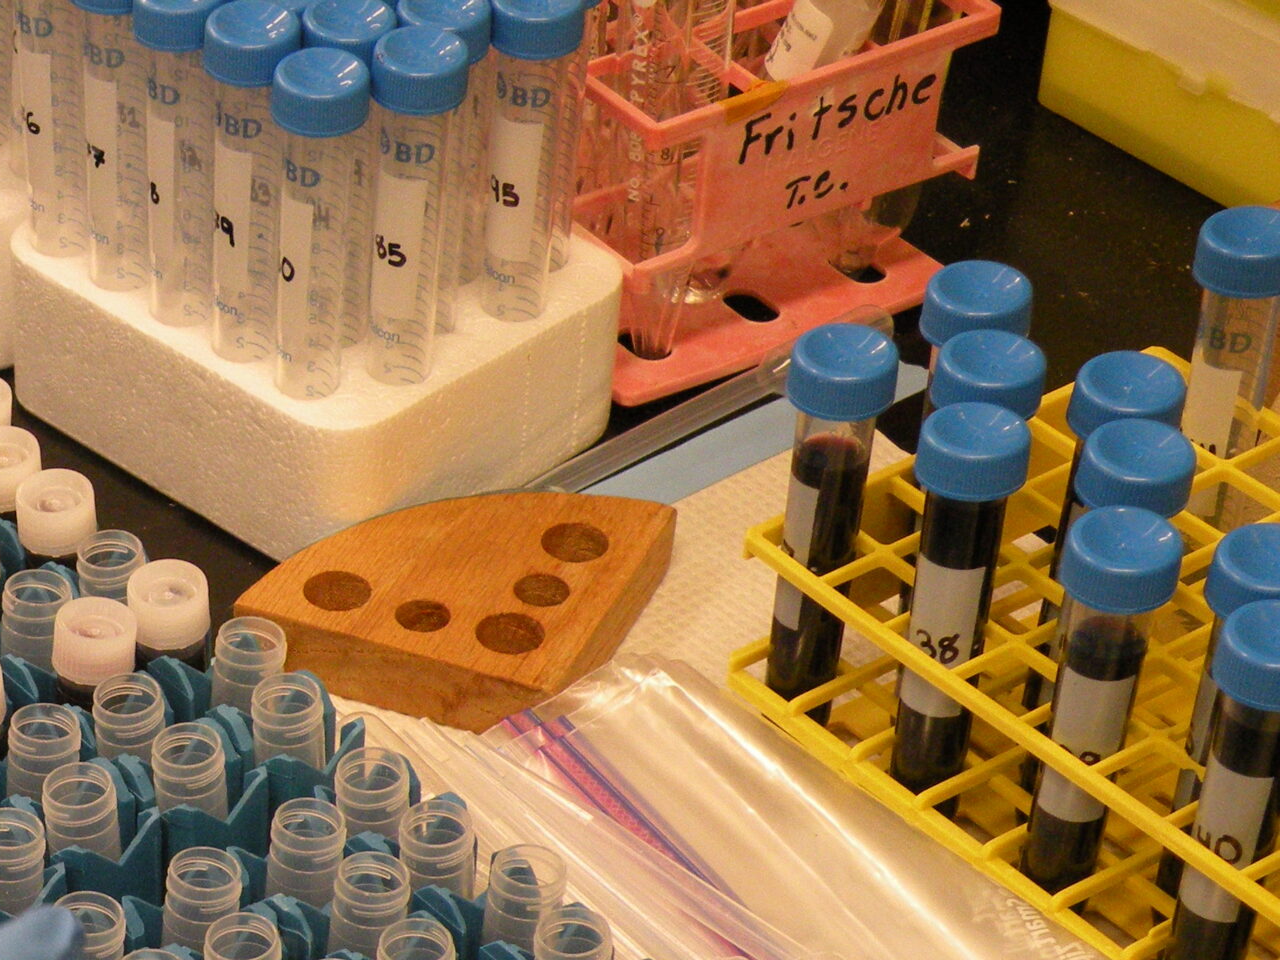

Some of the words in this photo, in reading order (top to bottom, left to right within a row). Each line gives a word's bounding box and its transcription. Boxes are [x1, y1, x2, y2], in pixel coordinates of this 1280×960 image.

[511, 84, 551, 108] BD
[223, 112, 263, 139] BD
[738, 73, 937, 165] Fritsche
[395, 139, 435, 165] BD
[285, 157, 320, 188] BD
[490, 174, 521, 208] 95
[375, 233, 407, 268] 85
[1208, 328, 1253, 354] BD
[915, 628, 961, 665] 38
